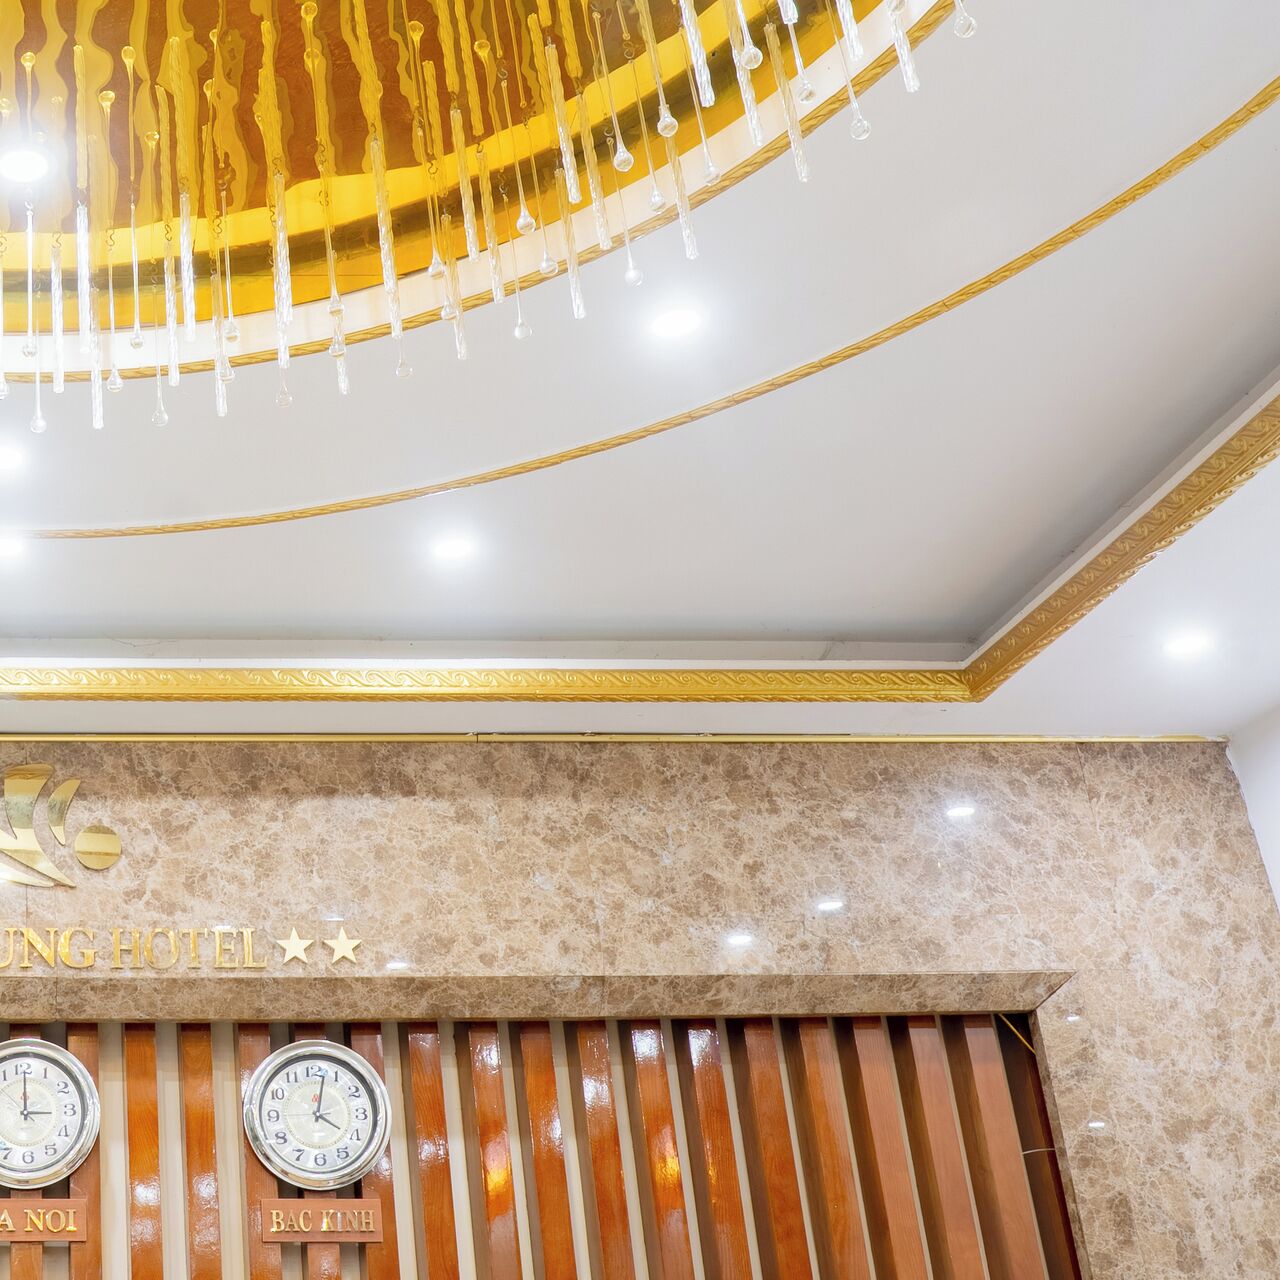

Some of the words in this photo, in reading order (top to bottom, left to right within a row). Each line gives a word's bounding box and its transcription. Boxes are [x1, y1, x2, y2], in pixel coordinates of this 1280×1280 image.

[110, 926, 268, 970] HOTEL
[15, 1063, 32, 1076] 12
[43, 1067, 48, 1079] 1
[334, 1070, 339, 1082] 1
[286, 1071, 298, 1083] 11
[57, 1081, 70, 1094] 2
[272, 1088, 284, 1100] 10
[348, 1085, 361, 1098] 2
[64, 1103, 76, 1117] 3
[267, 1110, 280, 1122] 9
[356, 1108, 368, 1120] 3
[58, 1125, 70, 1137] 4
[350, 1129, 361, 1141] 4
[275, 1132, 288, 1144] 8
[0, 1147, 12, 1160] 7
[45, 1143, 57, 1156] 5
[293, 1148, 305, 1162] 7
[337, 1146, 350, 1160] 5
[22, 1151, 34, 1164] 6
[314, 1153, 327, 1166] 6
[24, 1209, 78, 1232] NOI
[270, 1209, 312, 1232] BAC
[321, 1209, 376, 1232] KINH
